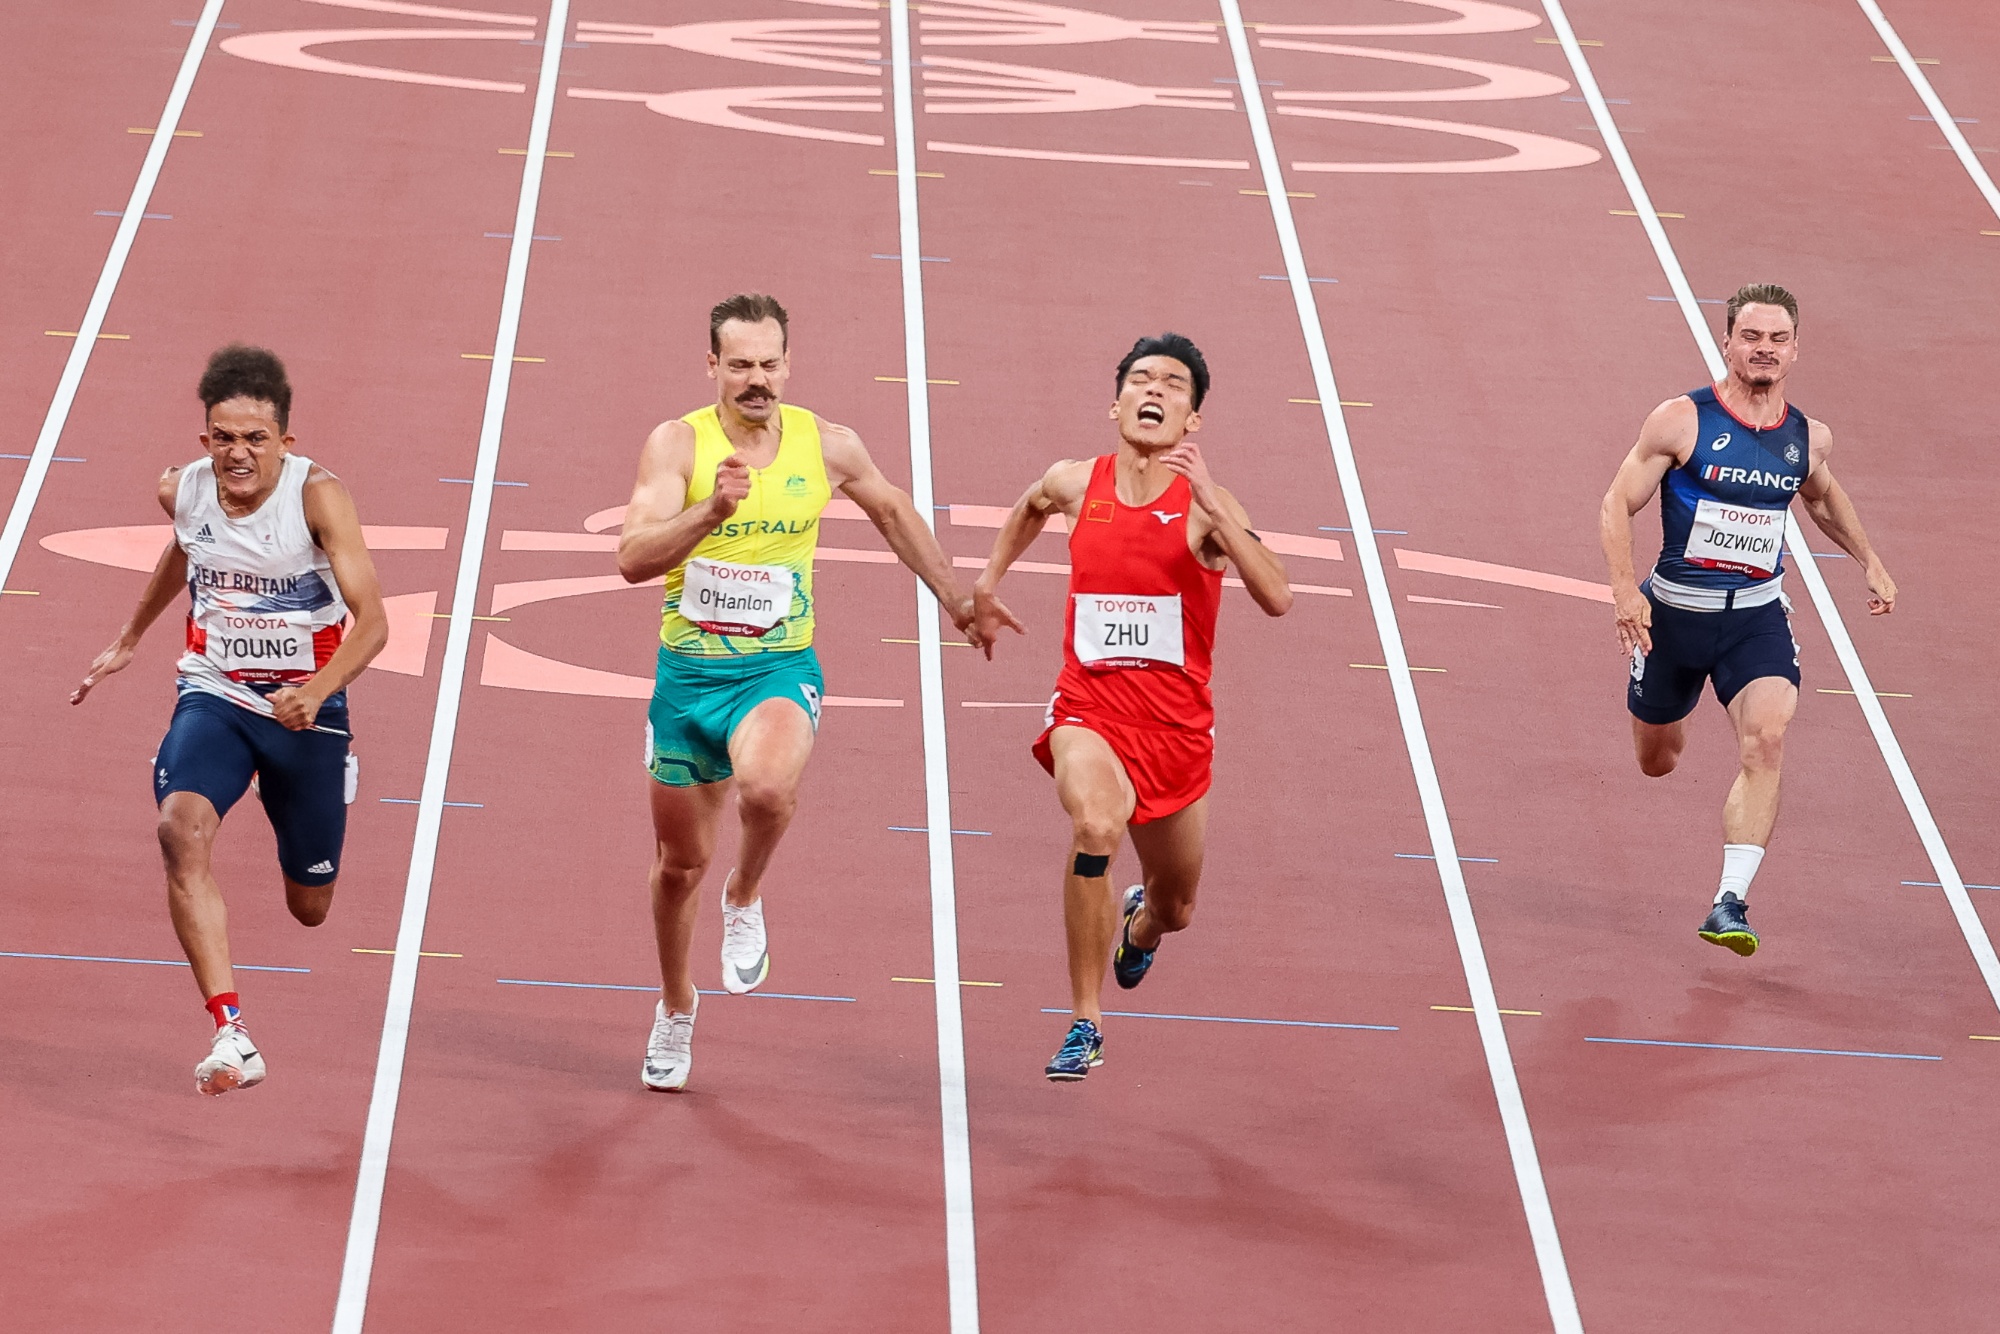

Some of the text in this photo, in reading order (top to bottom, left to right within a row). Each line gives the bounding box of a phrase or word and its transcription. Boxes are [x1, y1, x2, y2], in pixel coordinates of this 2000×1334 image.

[1718, 466, 1802, 492] FRANCE
[1719, 508, 1772, 526] TOYOTA
[1703, 529, 1774, 554] JOZWICKI
[195, 564, 298, 594] REAT BRITAIN
[709, 565, 771, 583] TOYOTA
[700, 588, 773, 612] O'Hanlon
[1095, 600, 1157, 614] TOYOTA
[224, 616, 289, 630] TOYOTA
[1104, 623, 1149, 646] ZHU
[220, 636, 298, 659] YOUNG
